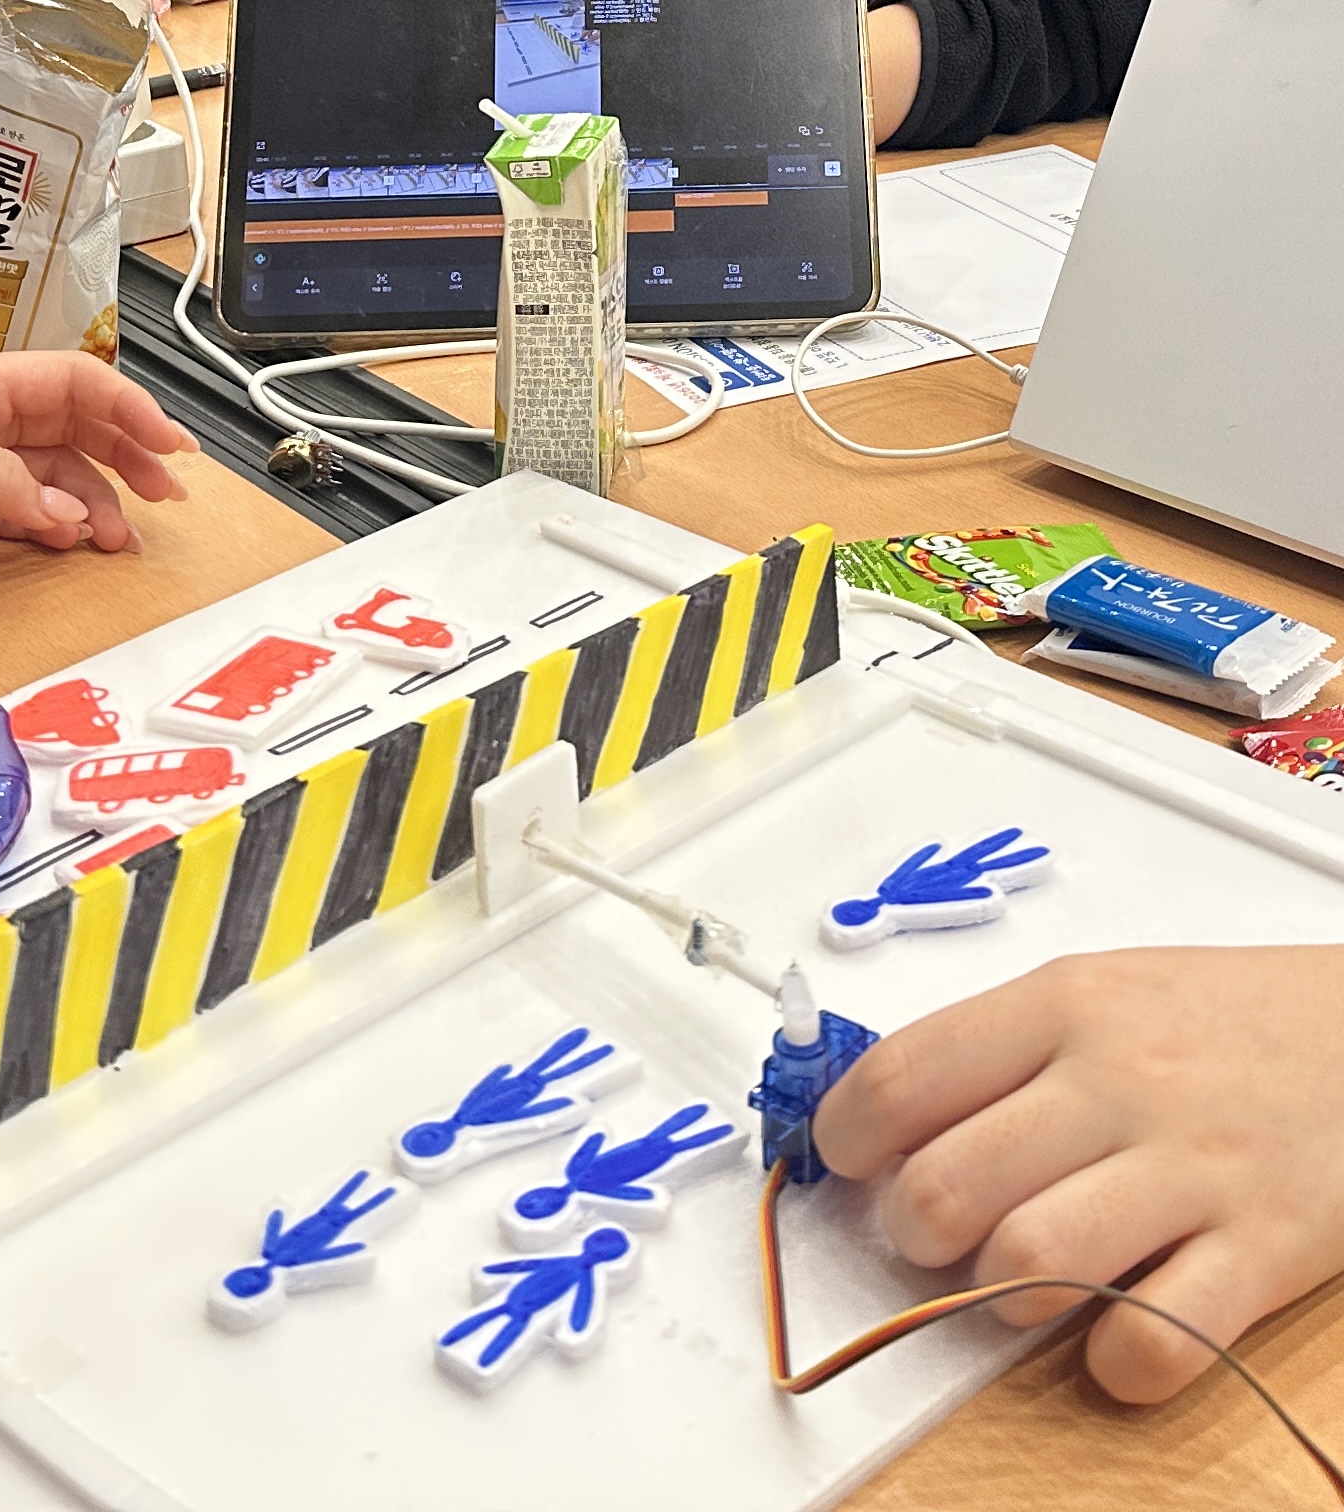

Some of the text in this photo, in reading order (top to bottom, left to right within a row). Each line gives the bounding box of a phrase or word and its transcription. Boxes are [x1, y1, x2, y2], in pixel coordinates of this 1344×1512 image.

[913, 535, 1027, 604] Skittle
[1090, 566, 1244, 630] アルフォート
[1111, 599, 1177, 624] BOURBON
